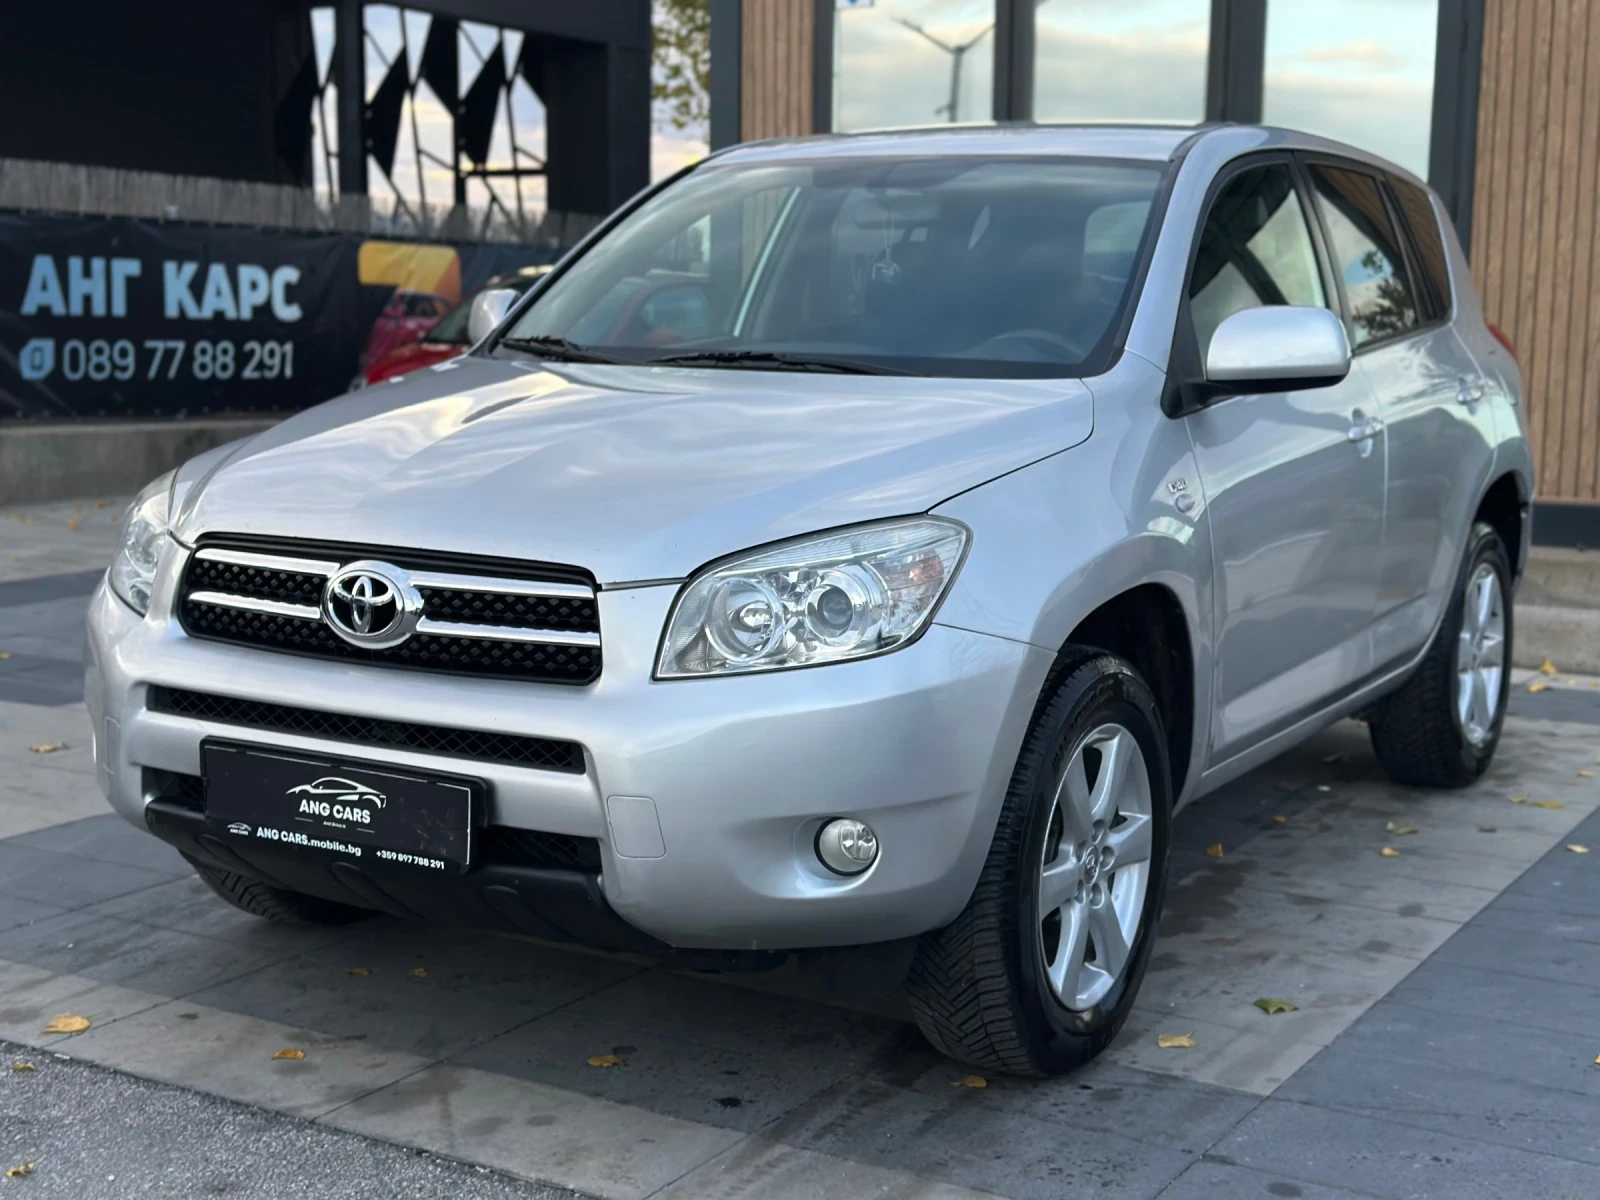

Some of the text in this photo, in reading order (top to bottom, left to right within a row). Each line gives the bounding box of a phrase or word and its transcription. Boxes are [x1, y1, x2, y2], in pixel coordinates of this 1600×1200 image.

[20, 254, 303, 322] АНГ КАРС
[62, 338, 294, 381] 089 77 88 291
[299, 798, 331, 817] ANG
[332, 804, 371, 824] CARS
[256, 826, 362, 857] ANG CARS.mobile.bg
[376, 849, 397, 860] +359
[397, 853, 413, 864] 897
[430, 859, 445, 870] 291
